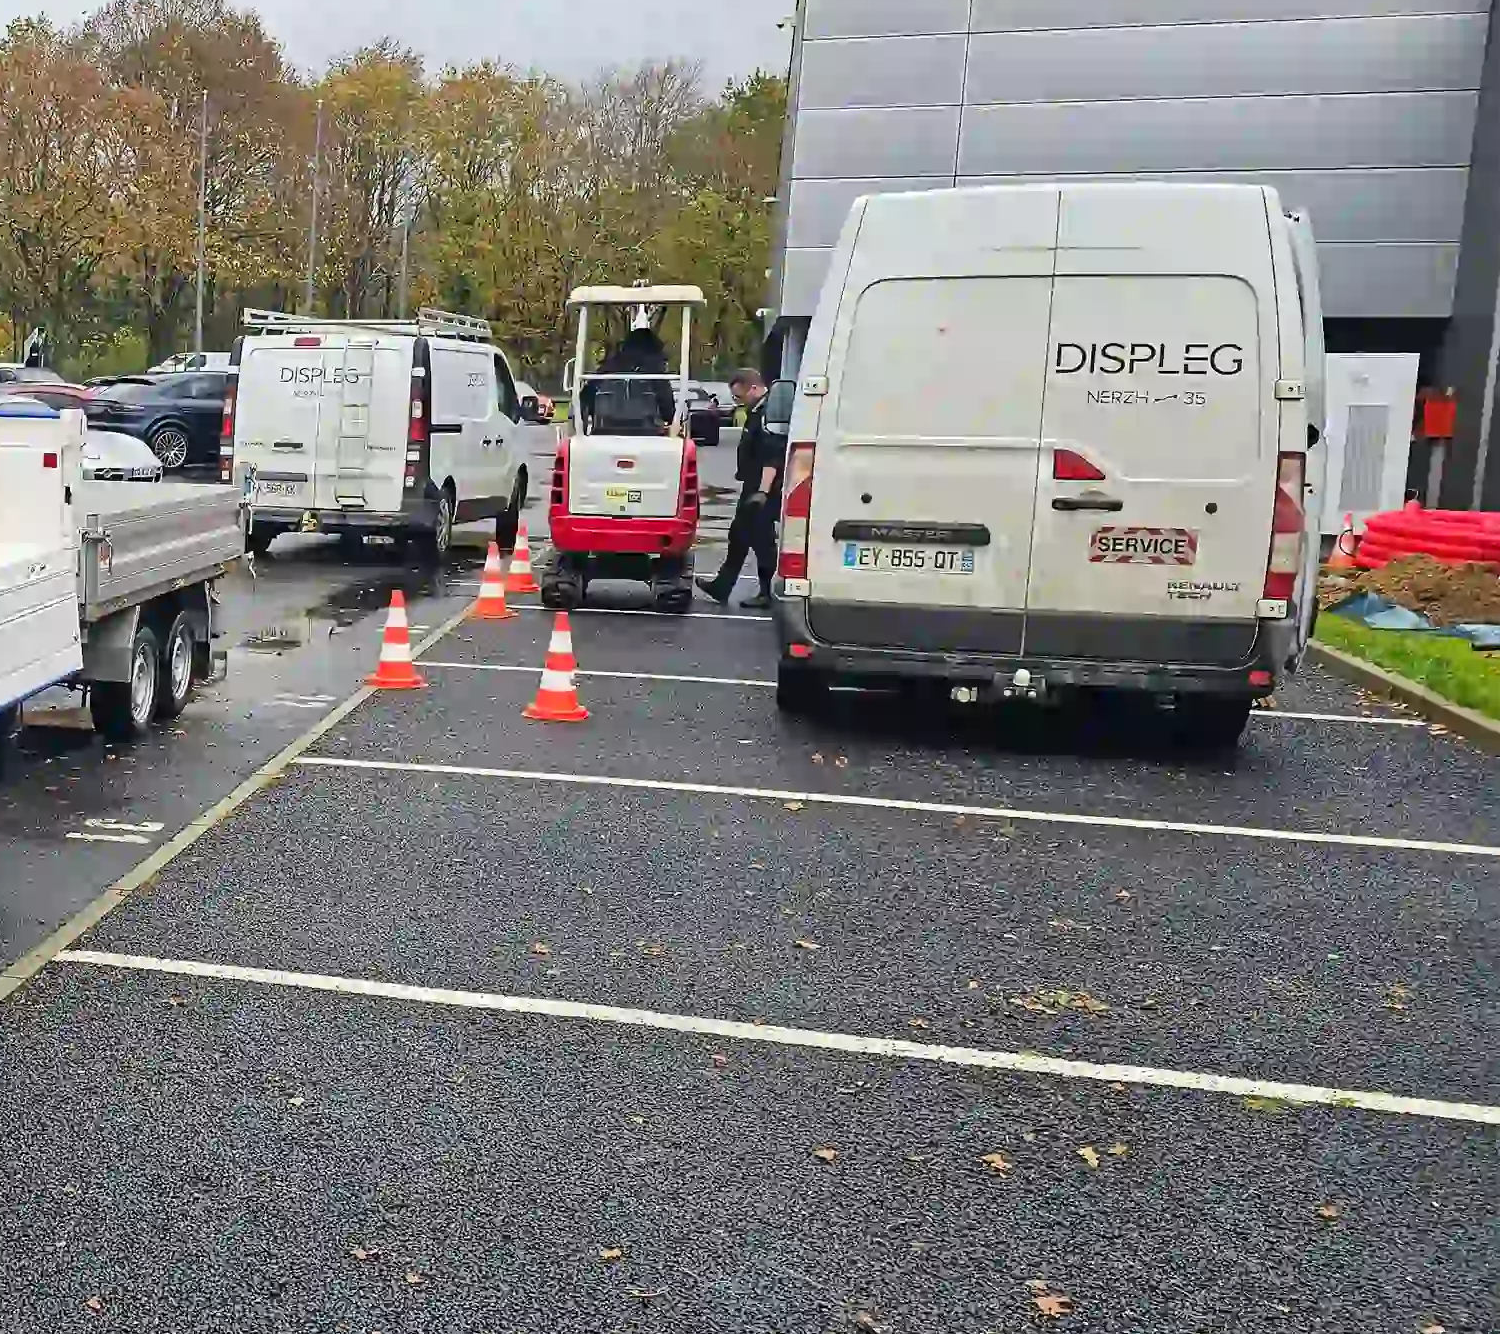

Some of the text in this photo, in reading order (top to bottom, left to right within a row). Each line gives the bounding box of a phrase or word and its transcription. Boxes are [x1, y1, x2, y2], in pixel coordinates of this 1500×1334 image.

[1055, 342, 1243, 375] DISPLEG
[279, 366, 360, 384] DISPLEG
[1087, 390, 1207, 405] NERZH 35
[1098, 537, 1187, 554] SERVICE
[1167, 580, 1240, 592] RENAULT
[1167, 591, 1212, 600] TECH
